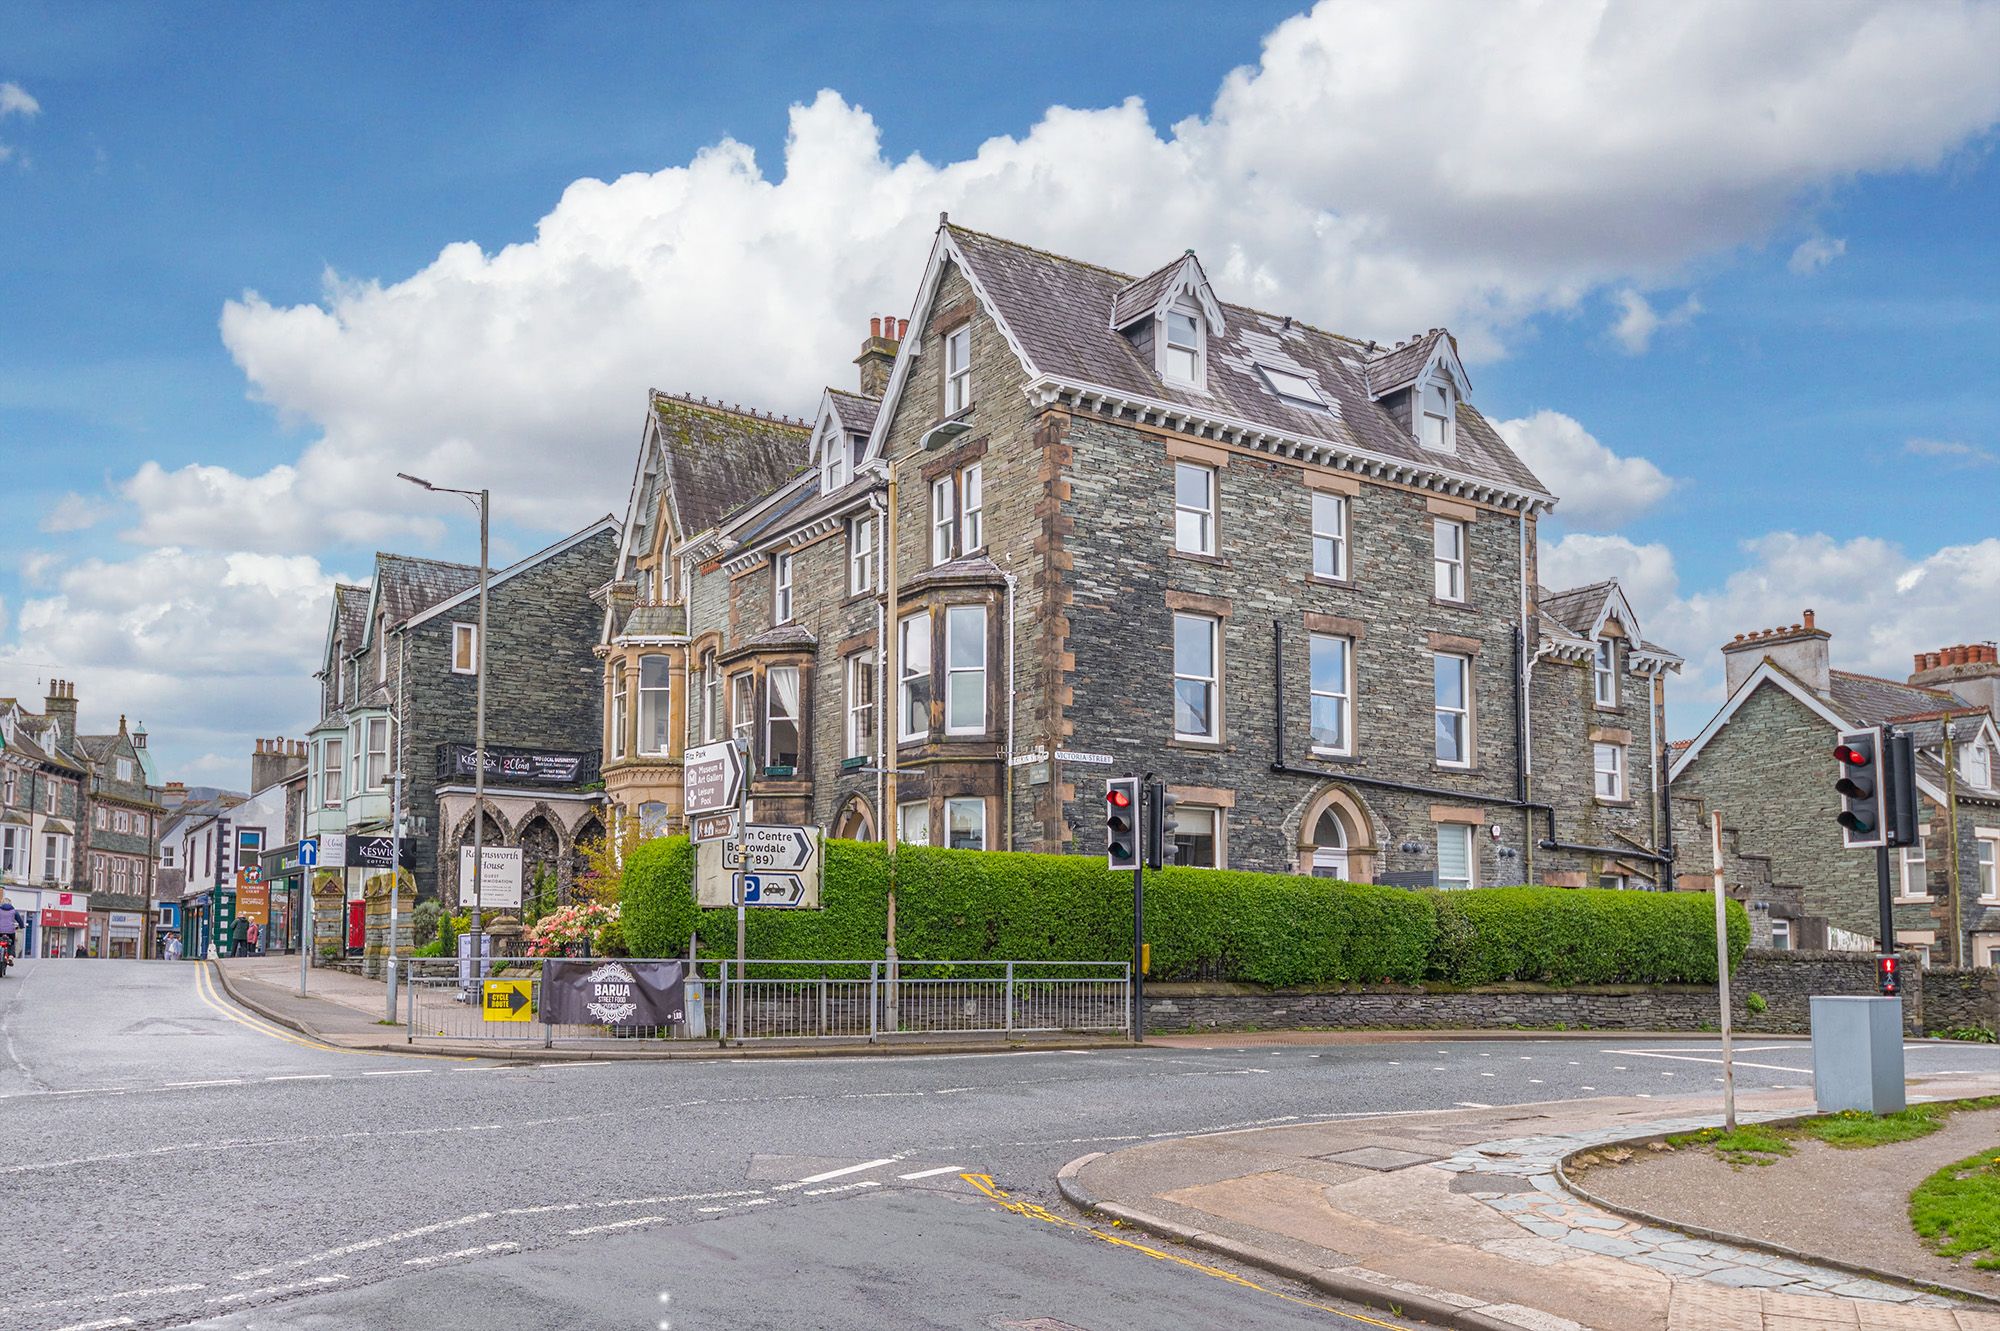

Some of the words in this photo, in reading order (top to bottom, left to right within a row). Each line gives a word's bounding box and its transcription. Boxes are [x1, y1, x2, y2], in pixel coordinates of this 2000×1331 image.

[461, 755, 496, 767] KESICK
[686, 752, 694, 760] Fitz
[1056, 752, 1086, 760] VICTORIA
[1088, 754, 1110, 762] STREET
[698, 764, 718, 774] Museum
[719, 762, 722, 770] &
[706, 774, 723, 782] Gallery
[698, 787, 714, 796] Leisure
[701, 797, 712, 805] Pool
[758, 830, 792, 841] Centre
[727, 842, 786, 853] Borowdale
[466, 850, 518, 859] Raensworth
[727, 853, 774, 866] (B89)
[744, 880, 755, 898] P
[594, 984, 630, 996] BARUA
